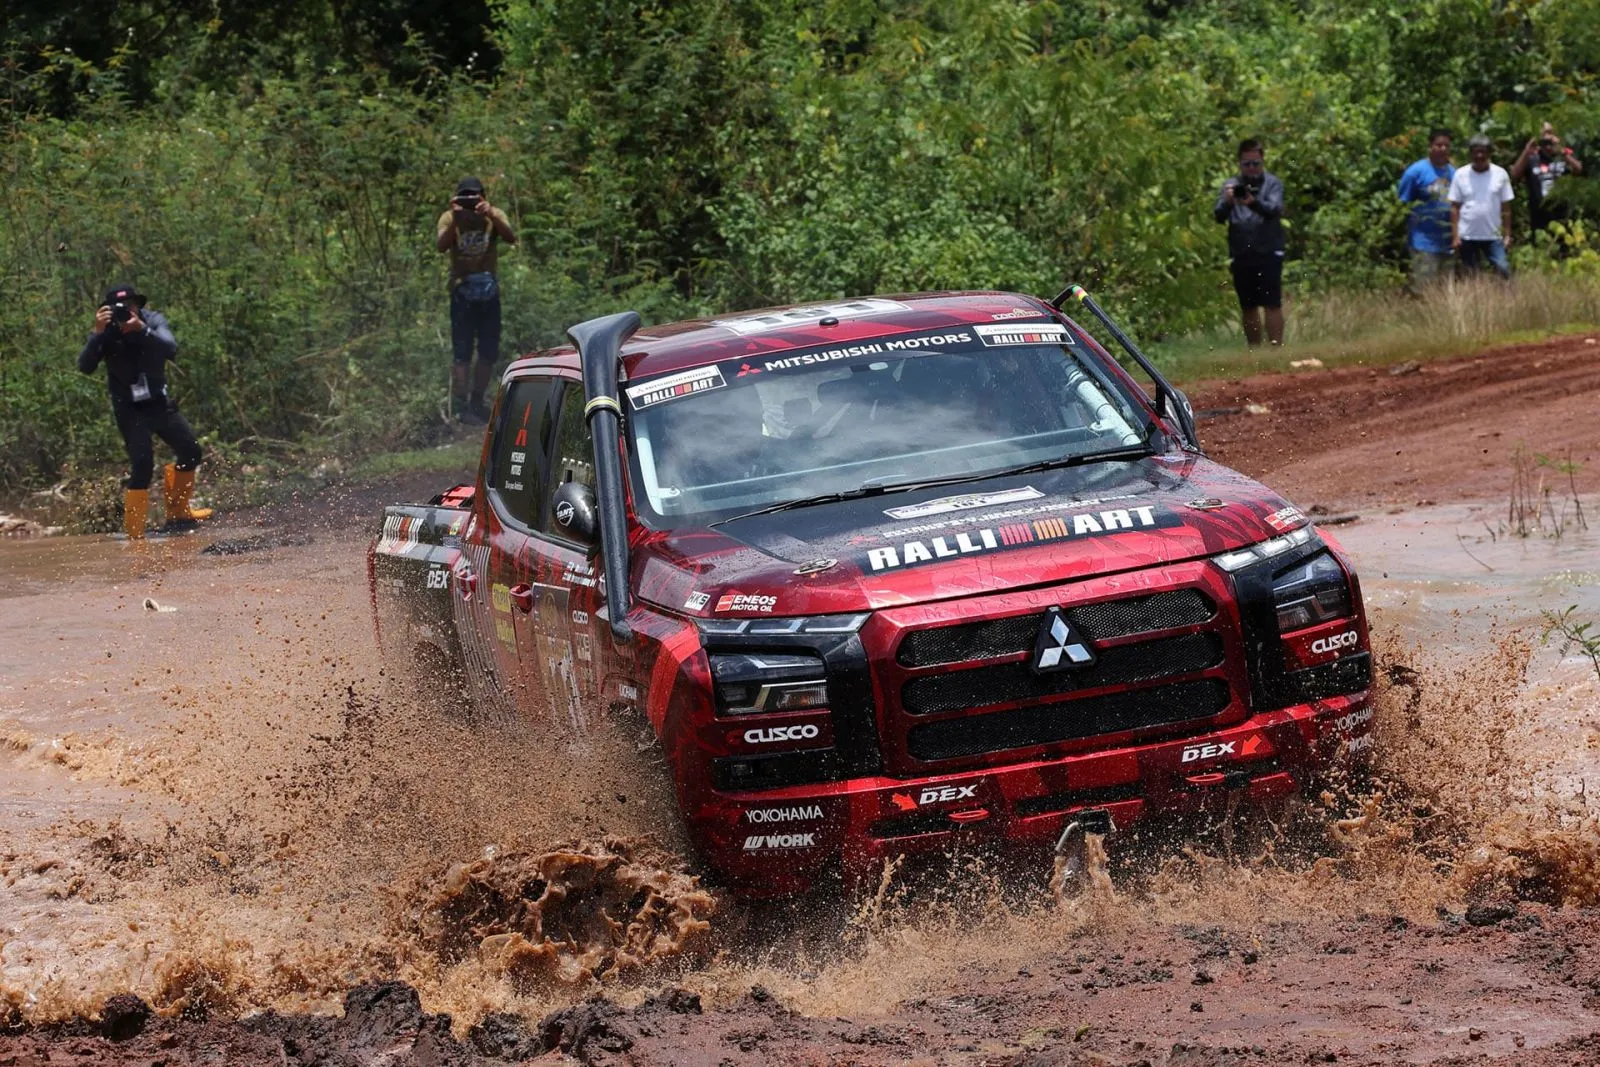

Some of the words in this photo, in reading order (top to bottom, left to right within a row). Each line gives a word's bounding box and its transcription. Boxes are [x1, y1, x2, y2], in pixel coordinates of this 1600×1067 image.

[764, 344, 883, 371] MITSUBISHI
[887, 333, 972, 351] MOTORS
[867, 528, 998, 571] RALLI
[1074, 505, 1157, 534] ART
[427, 570, 450, 589] DEX
[730, 603, 758, 611] MOTOR
[760, 604, 773, 612] OIL
[734, 595, 777, 606] ENEOS
[1311, 630, 1358, 654] CUSCO
[744, 724, 819, 744] CUSCO
[1181, 740, 1236, 763] DEX
[919, 784, 978, 805] DEX
[744, 805, 825, 823] YOKOHAMA
[766, 832, 816, 848] WORK
